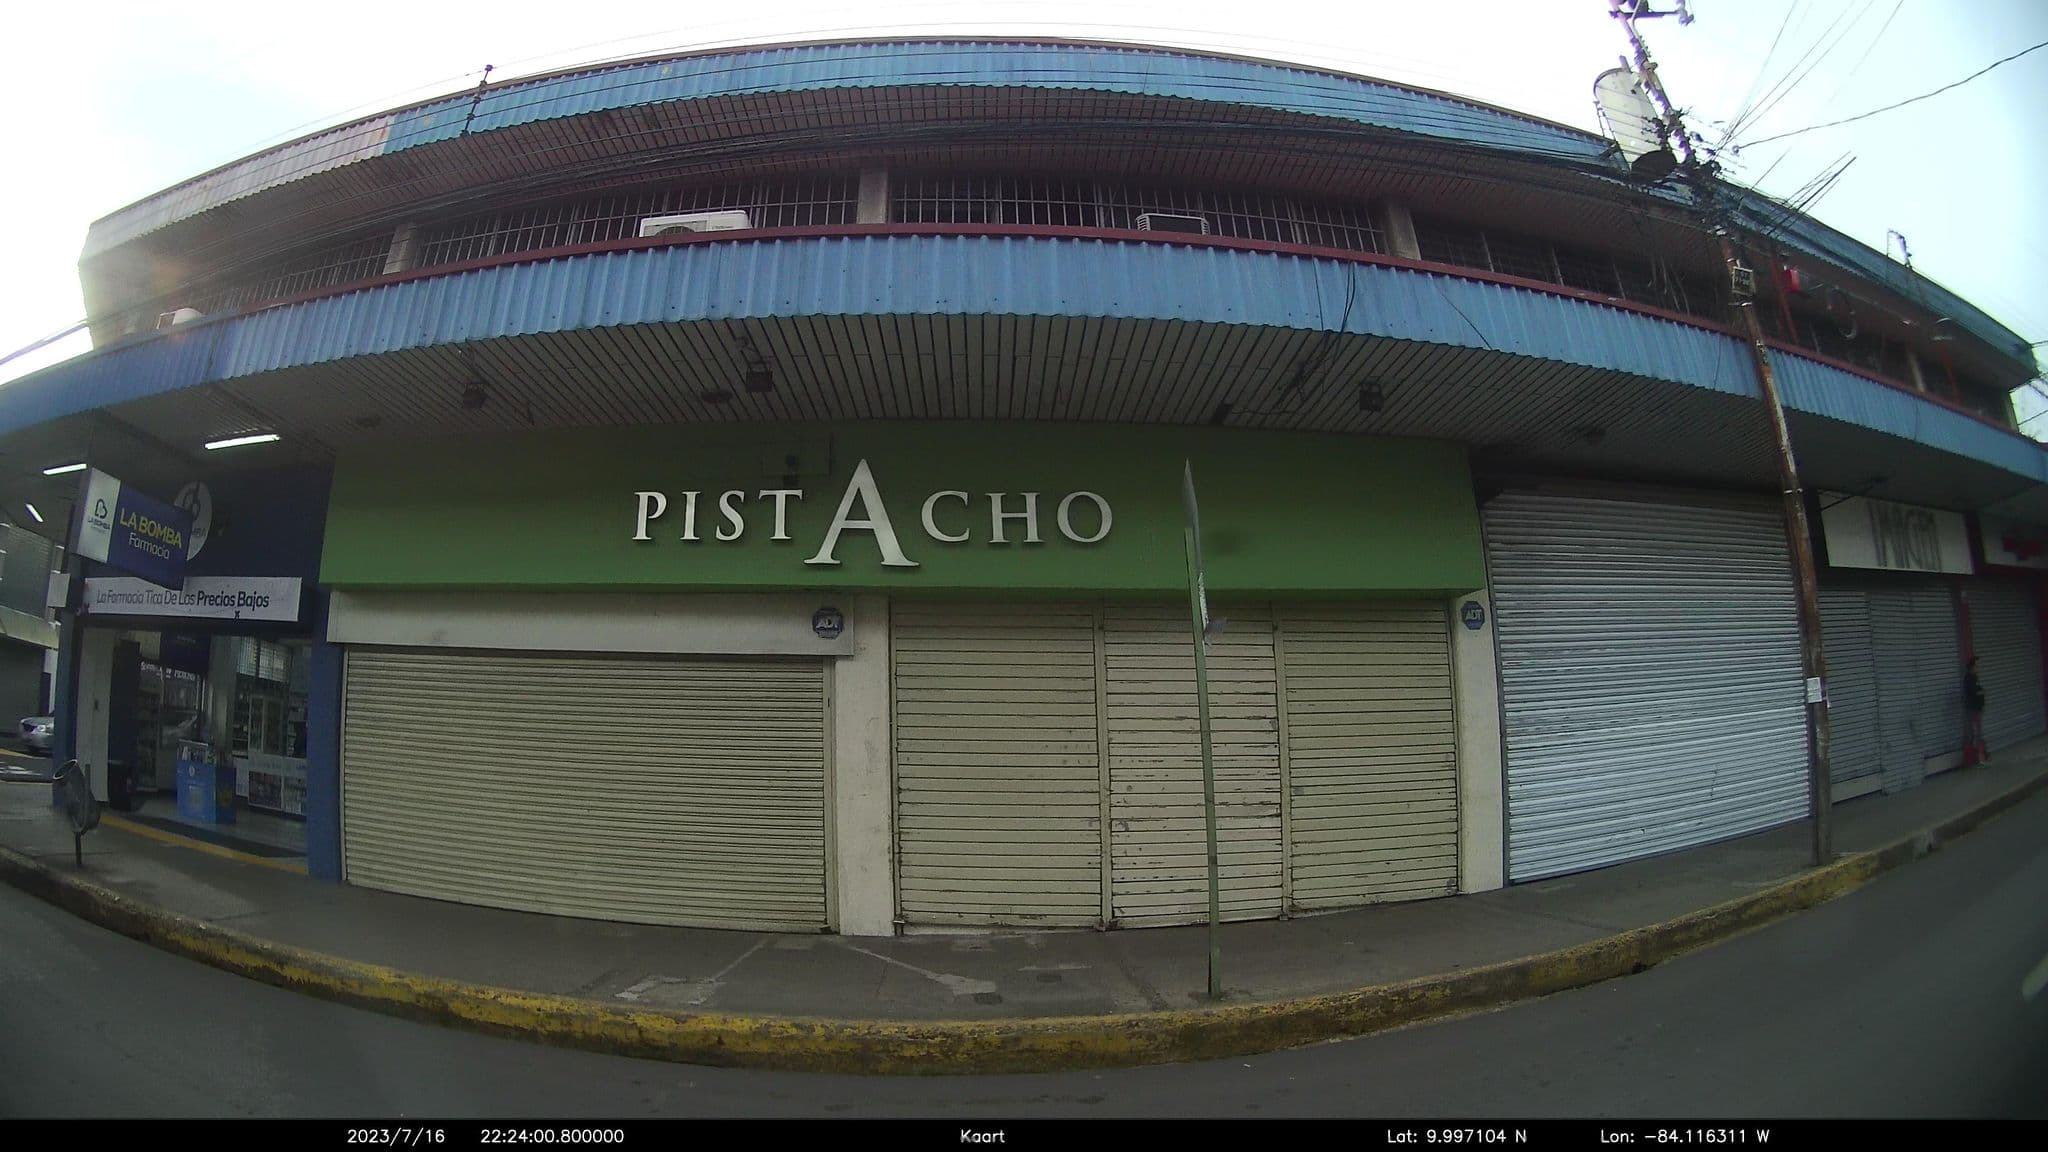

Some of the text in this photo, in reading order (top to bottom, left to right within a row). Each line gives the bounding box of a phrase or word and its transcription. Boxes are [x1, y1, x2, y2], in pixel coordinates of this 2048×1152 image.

[632, 458, 1113, 568] PISTACHO
[120, 507, 182, 549] LA BOMBA
[128, 532, 170, 560] Farmacia
[97, 589, 107, 604] La
[107, 589, 145, 605] Farmacia
[145, 590, 165, 605] Tica
[165, 590, 178, 605] De
[197, 590, 236, 608] Precios
[238, 591, 270, 611] Bajos
[1465, 609, 1482, 621] ADT
